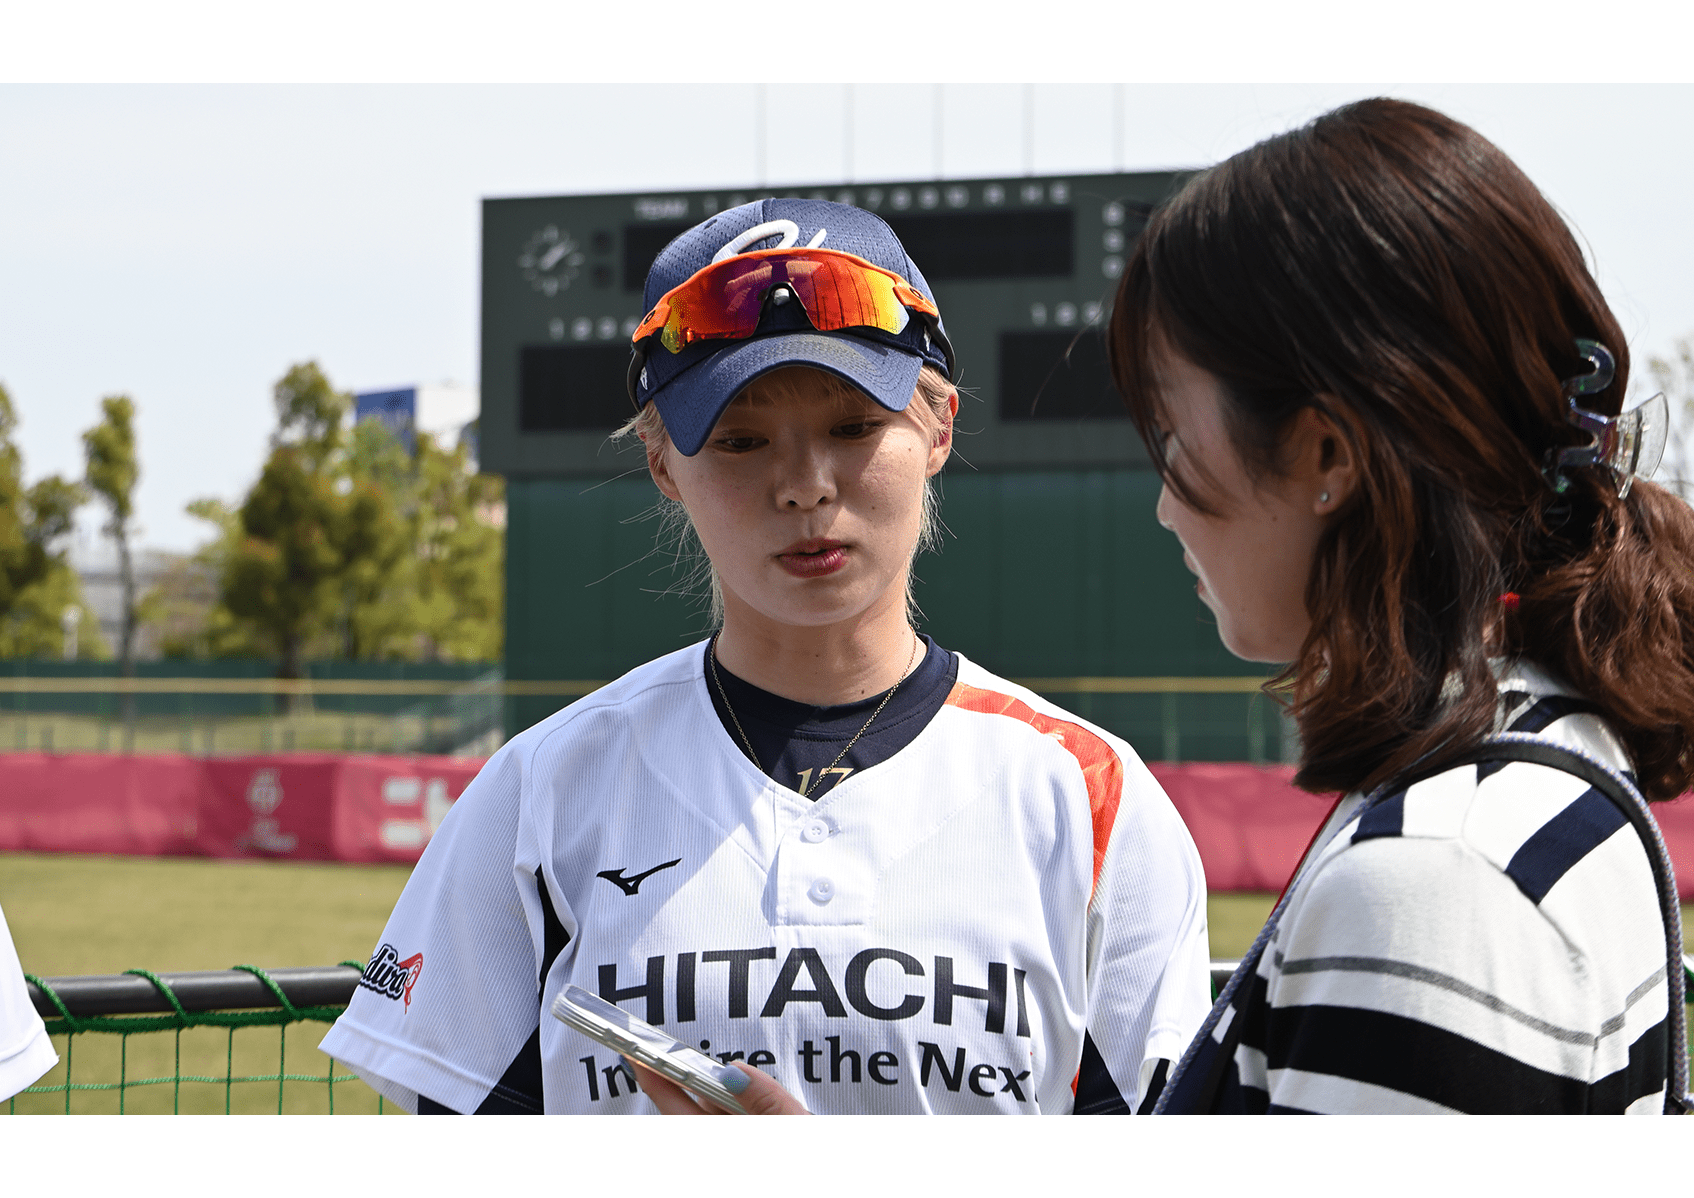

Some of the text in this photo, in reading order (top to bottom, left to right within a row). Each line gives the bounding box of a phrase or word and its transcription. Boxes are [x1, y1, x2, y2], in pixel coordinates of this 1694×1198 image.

[797, 768, 854, 796] 17
[598, 947, 1031, 1038] HITACHI
[798, 1036, 899, 1085] the
[918, 1041, 1038, 1103] Nex
